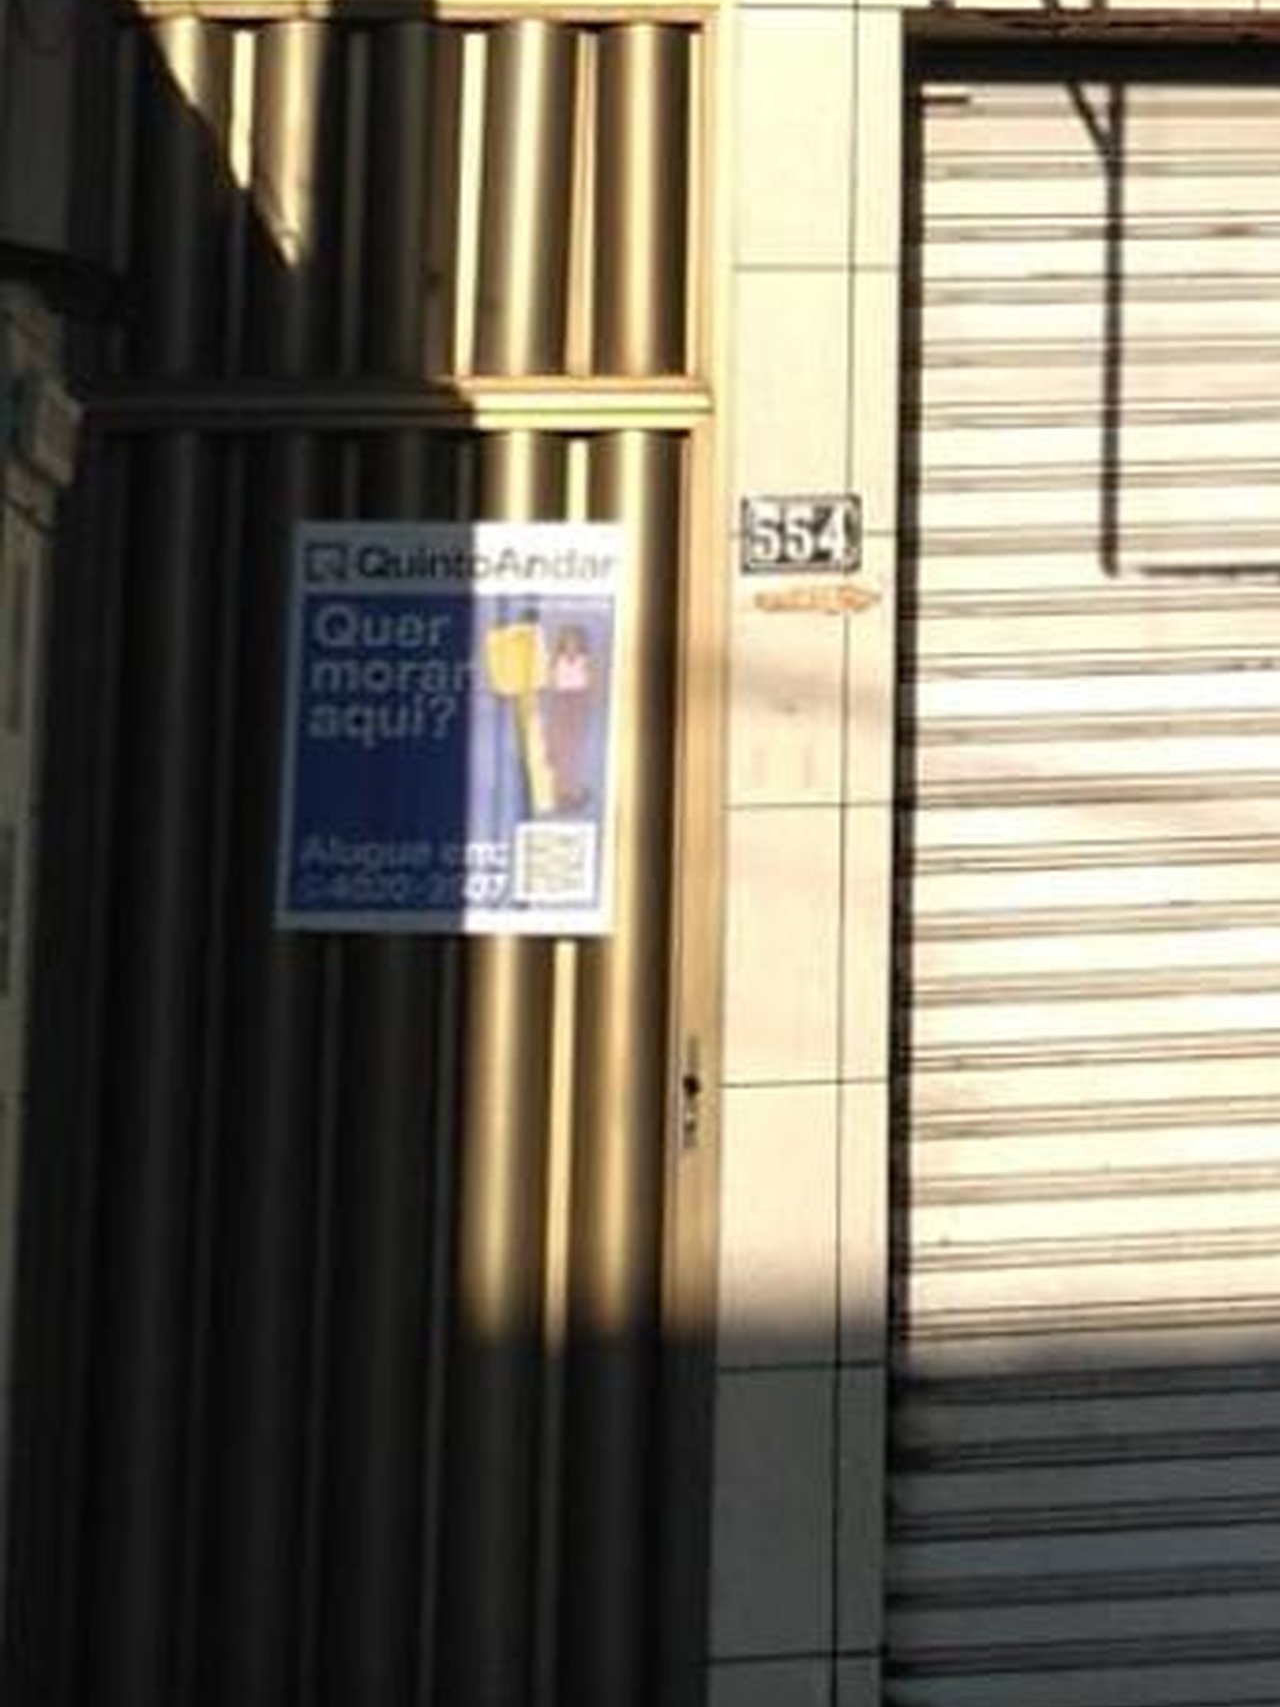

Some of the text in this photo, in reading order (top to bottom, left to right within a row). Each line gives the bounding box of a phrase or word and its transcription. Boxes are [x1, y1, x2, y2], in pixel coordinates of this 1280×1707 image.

[749, 499, 853, 563] 554
[357, 545, 616, 579] QuintoAndar
[313, 603, 452, 647] Quer
[309, 659, 480, 691] morar
[308, 695, 456, 747] aqui?
